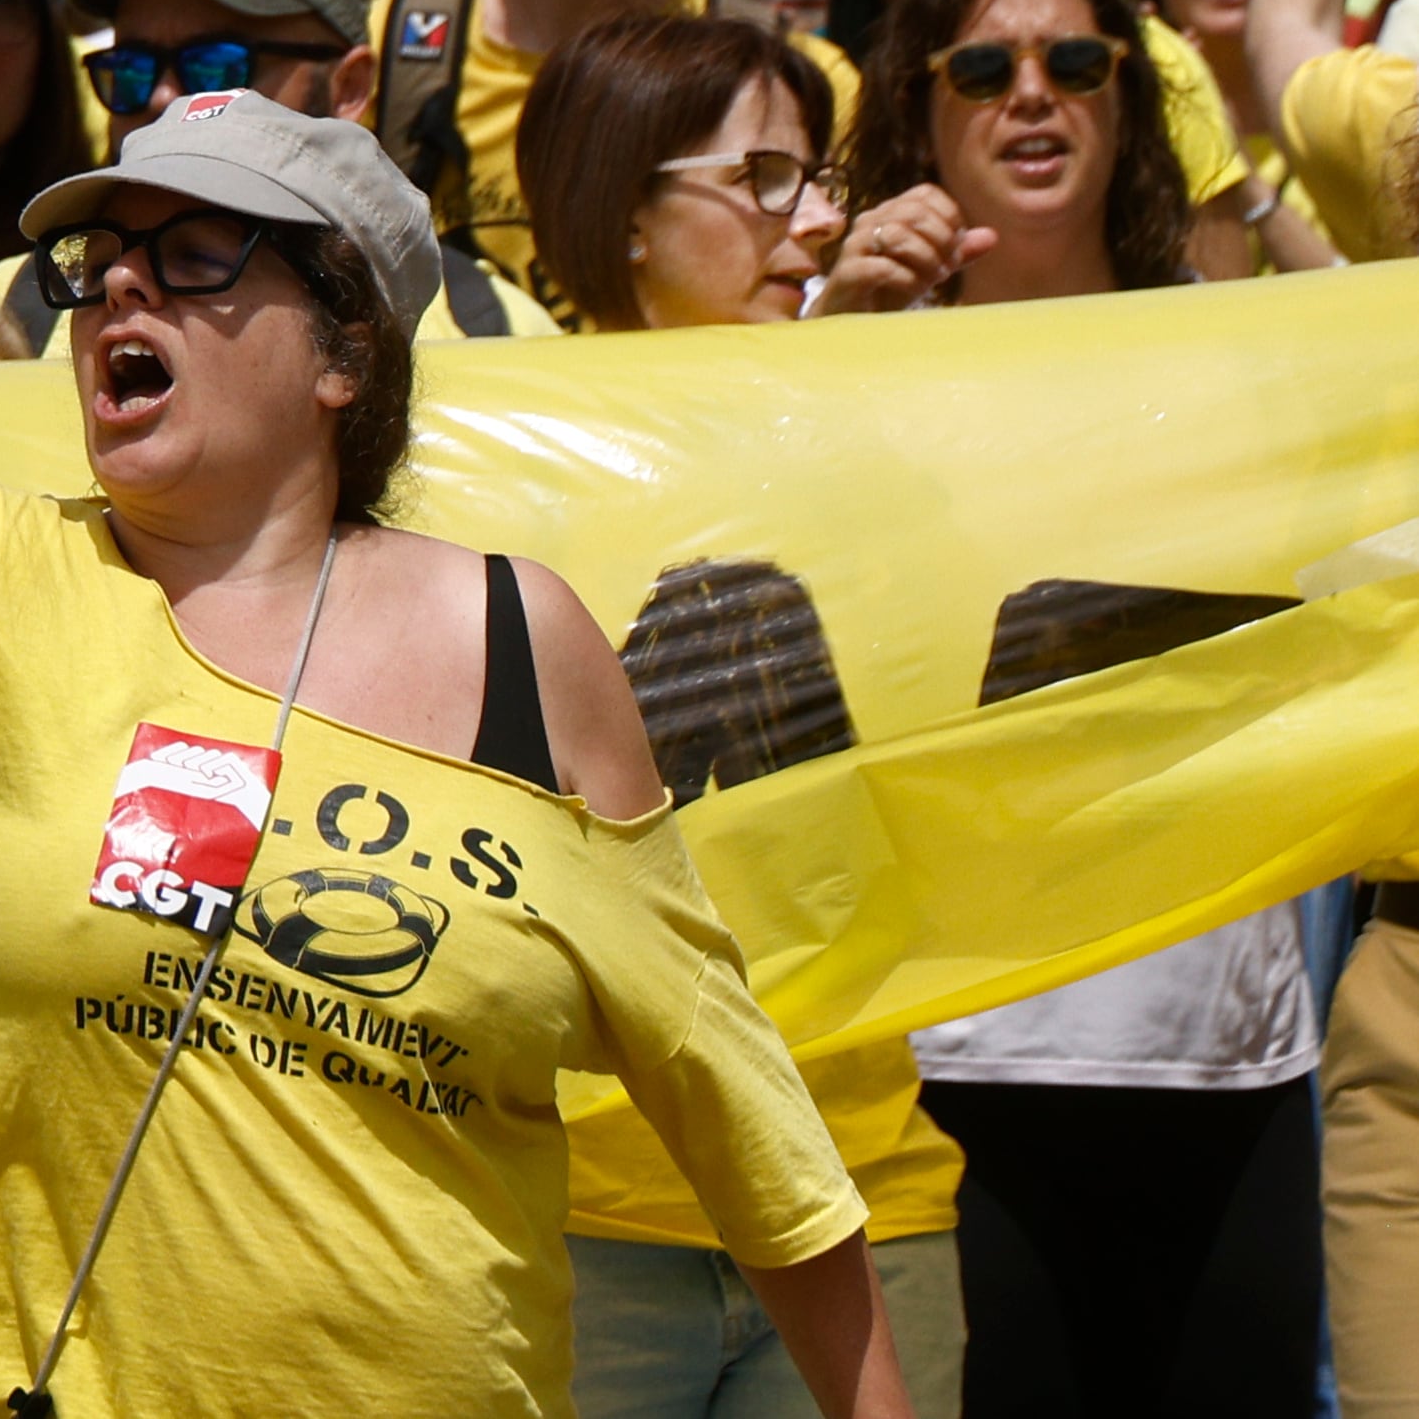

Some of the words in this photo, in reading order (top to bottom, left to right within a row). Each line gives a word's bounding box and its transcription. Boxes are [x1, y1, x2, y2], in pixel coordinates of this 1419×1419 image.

[185, 104, 225, 121] CGT
[271, 783, 539, 917] .O.S.
[99, 860, 234, 933] CGT
[249, 1033, 309, 1078] DE
